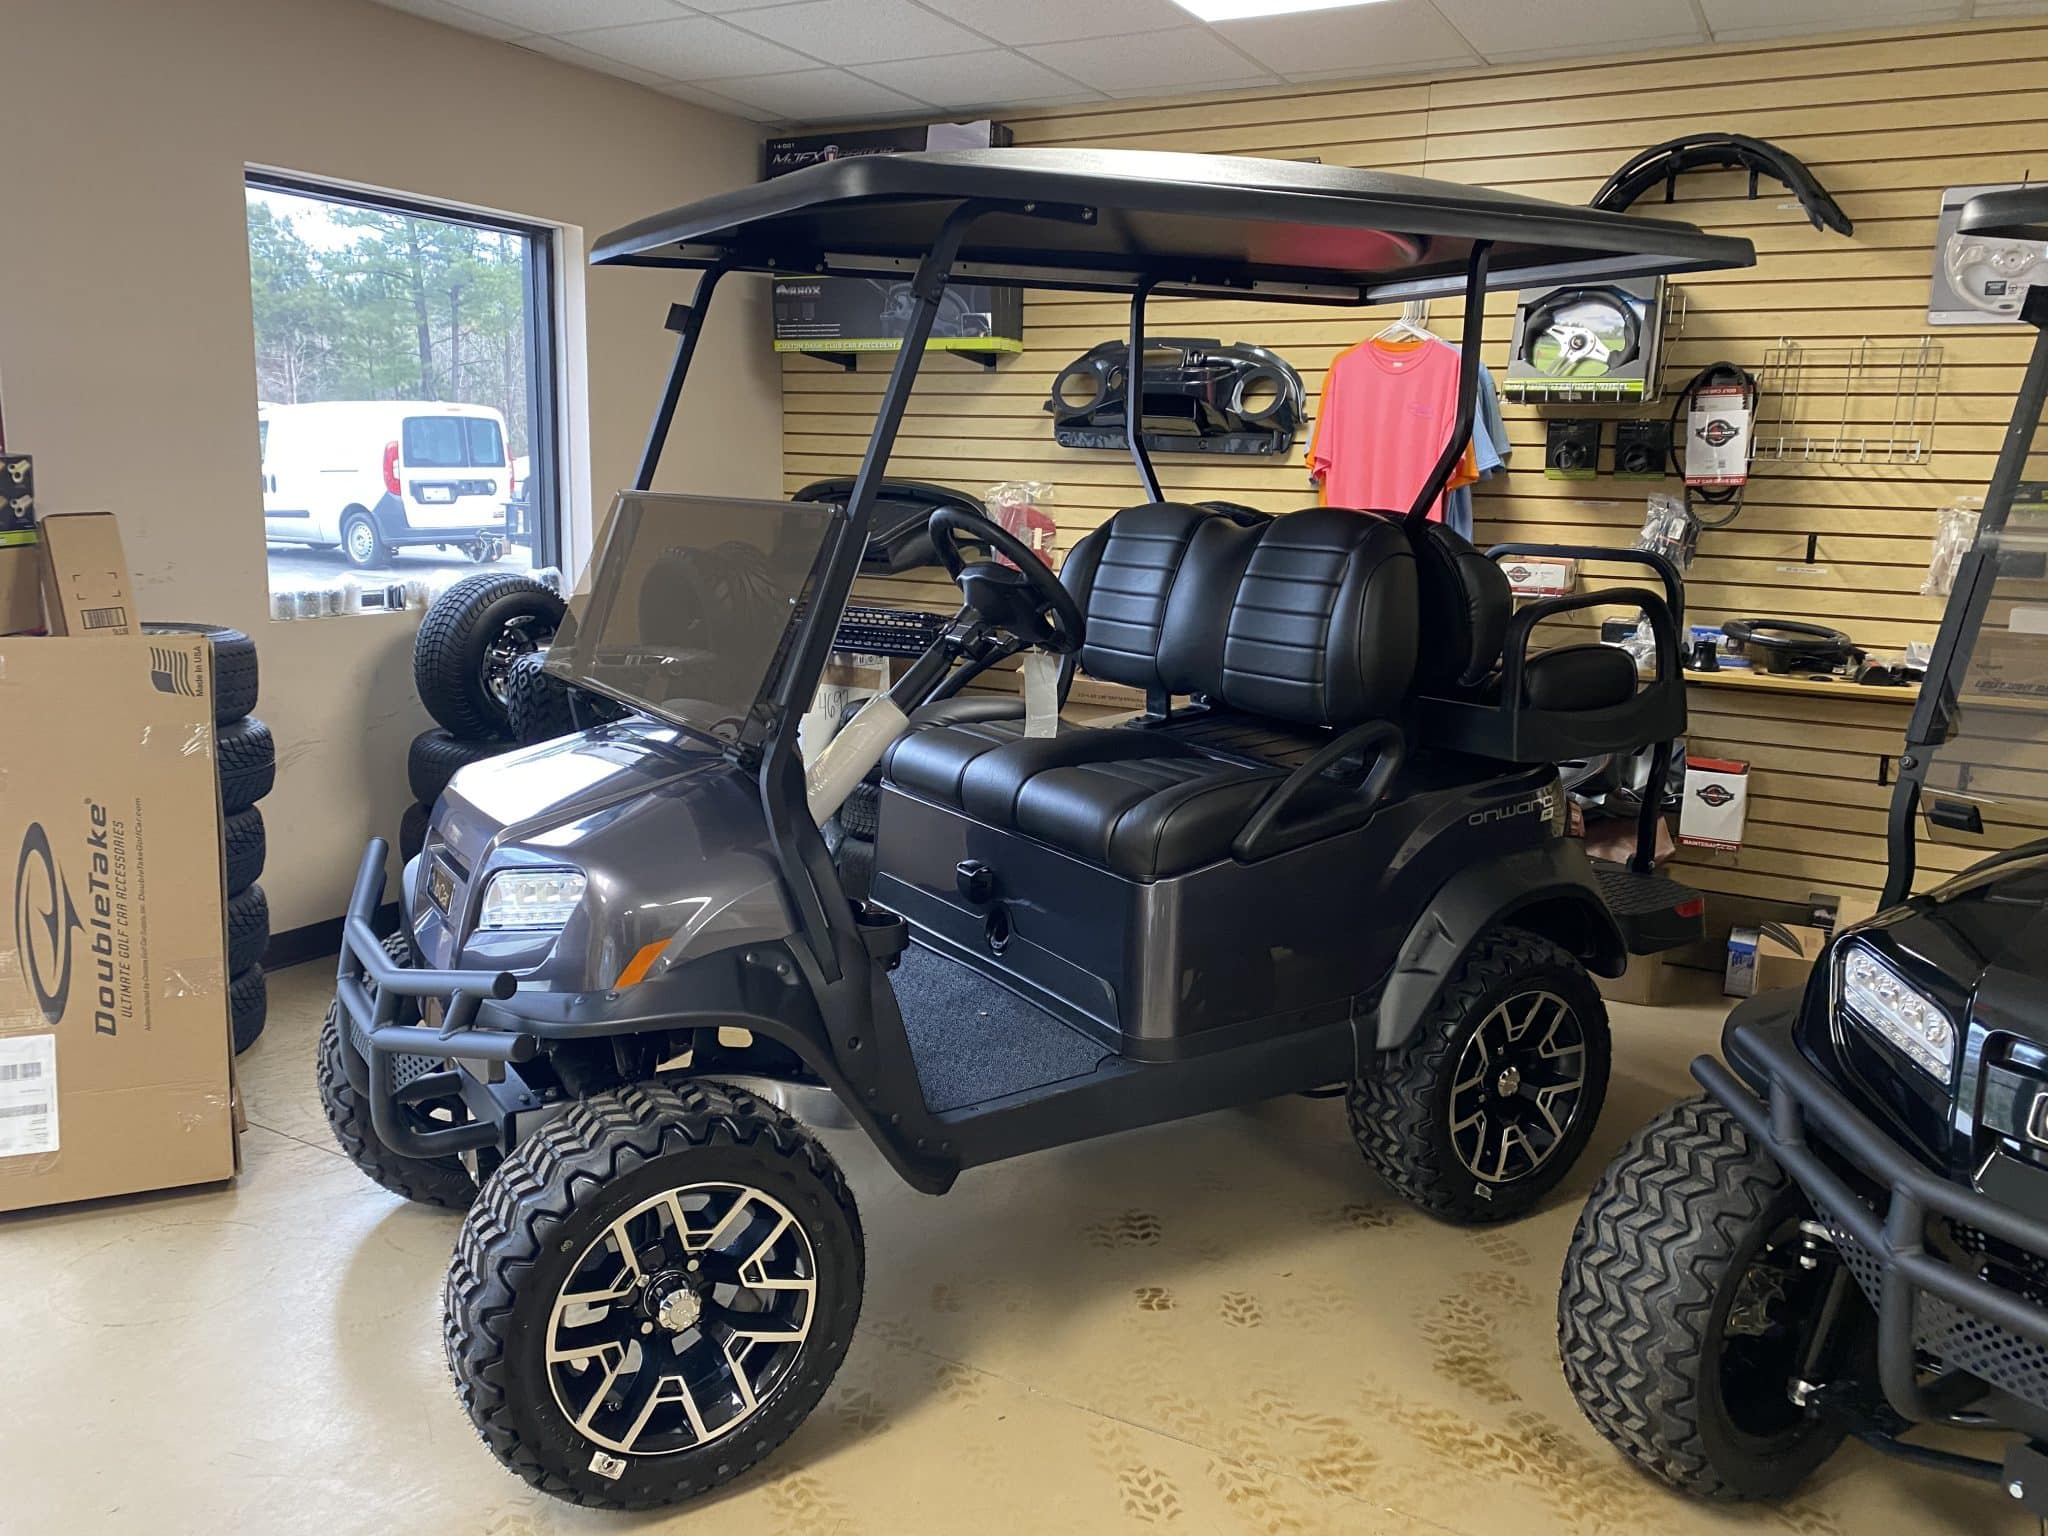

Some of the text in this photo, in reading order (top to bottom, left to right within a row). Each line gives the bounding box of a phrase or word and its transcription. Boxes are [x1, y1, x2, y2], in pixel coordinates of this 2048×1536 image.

[193, 645, 202, 663] USA
[195, 674, 205, 697] Made
[86, 803, 117, 1037] DoubleTake
[112, 820, 134, 1019] ULTIMATE GOLF CAR ACCESSORIES
